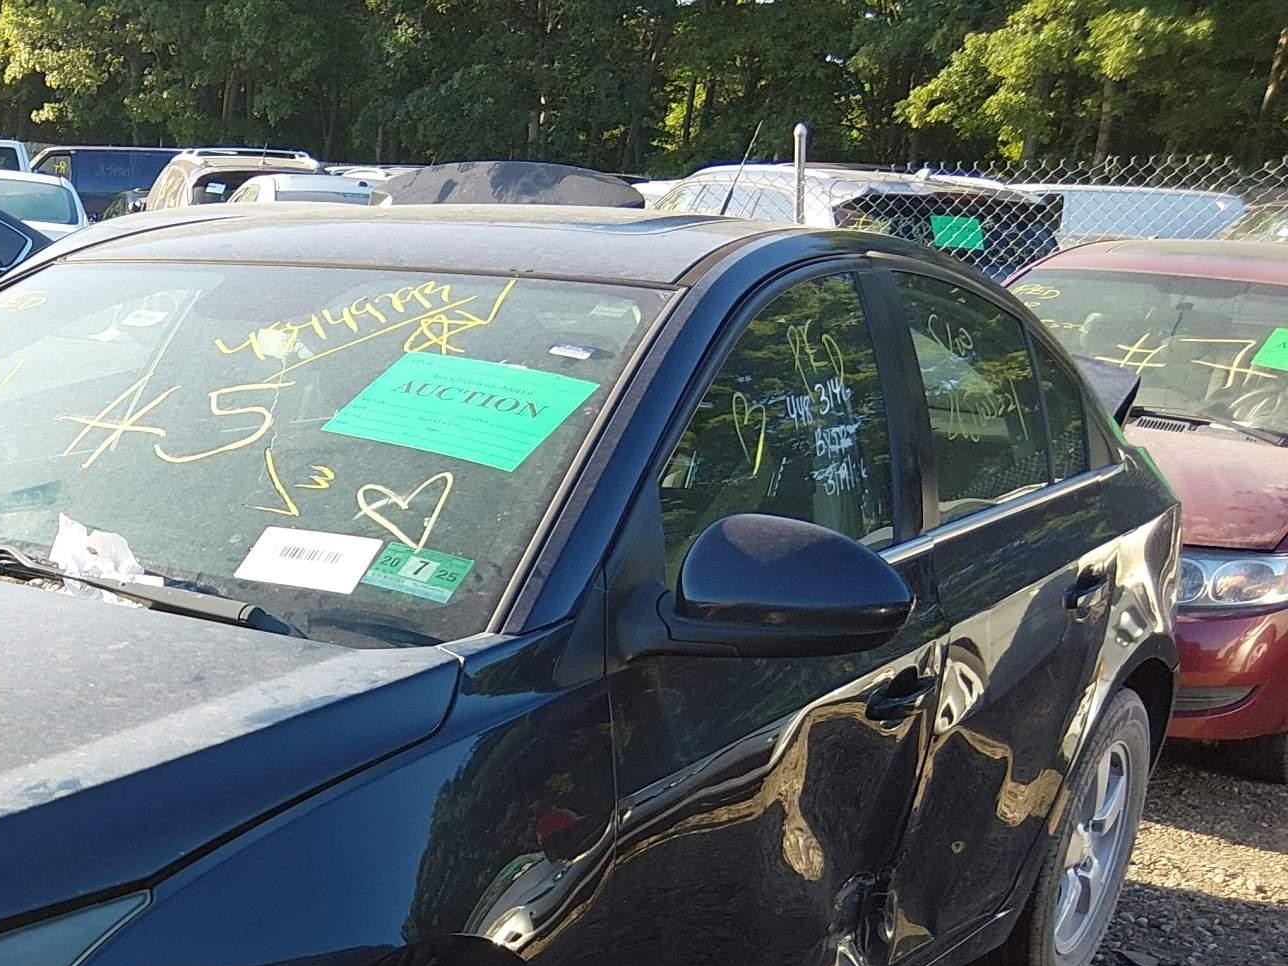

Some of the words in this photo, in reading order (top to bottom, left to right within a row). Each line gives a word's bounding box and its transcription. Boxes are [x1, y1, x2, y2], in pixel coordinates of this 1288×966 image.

[392, 380, 553, 418] AUCTION
[379, 554, 402, 568] 20
[412, 560, 430, 576] 7
[435, 569, 458, 584] 25
